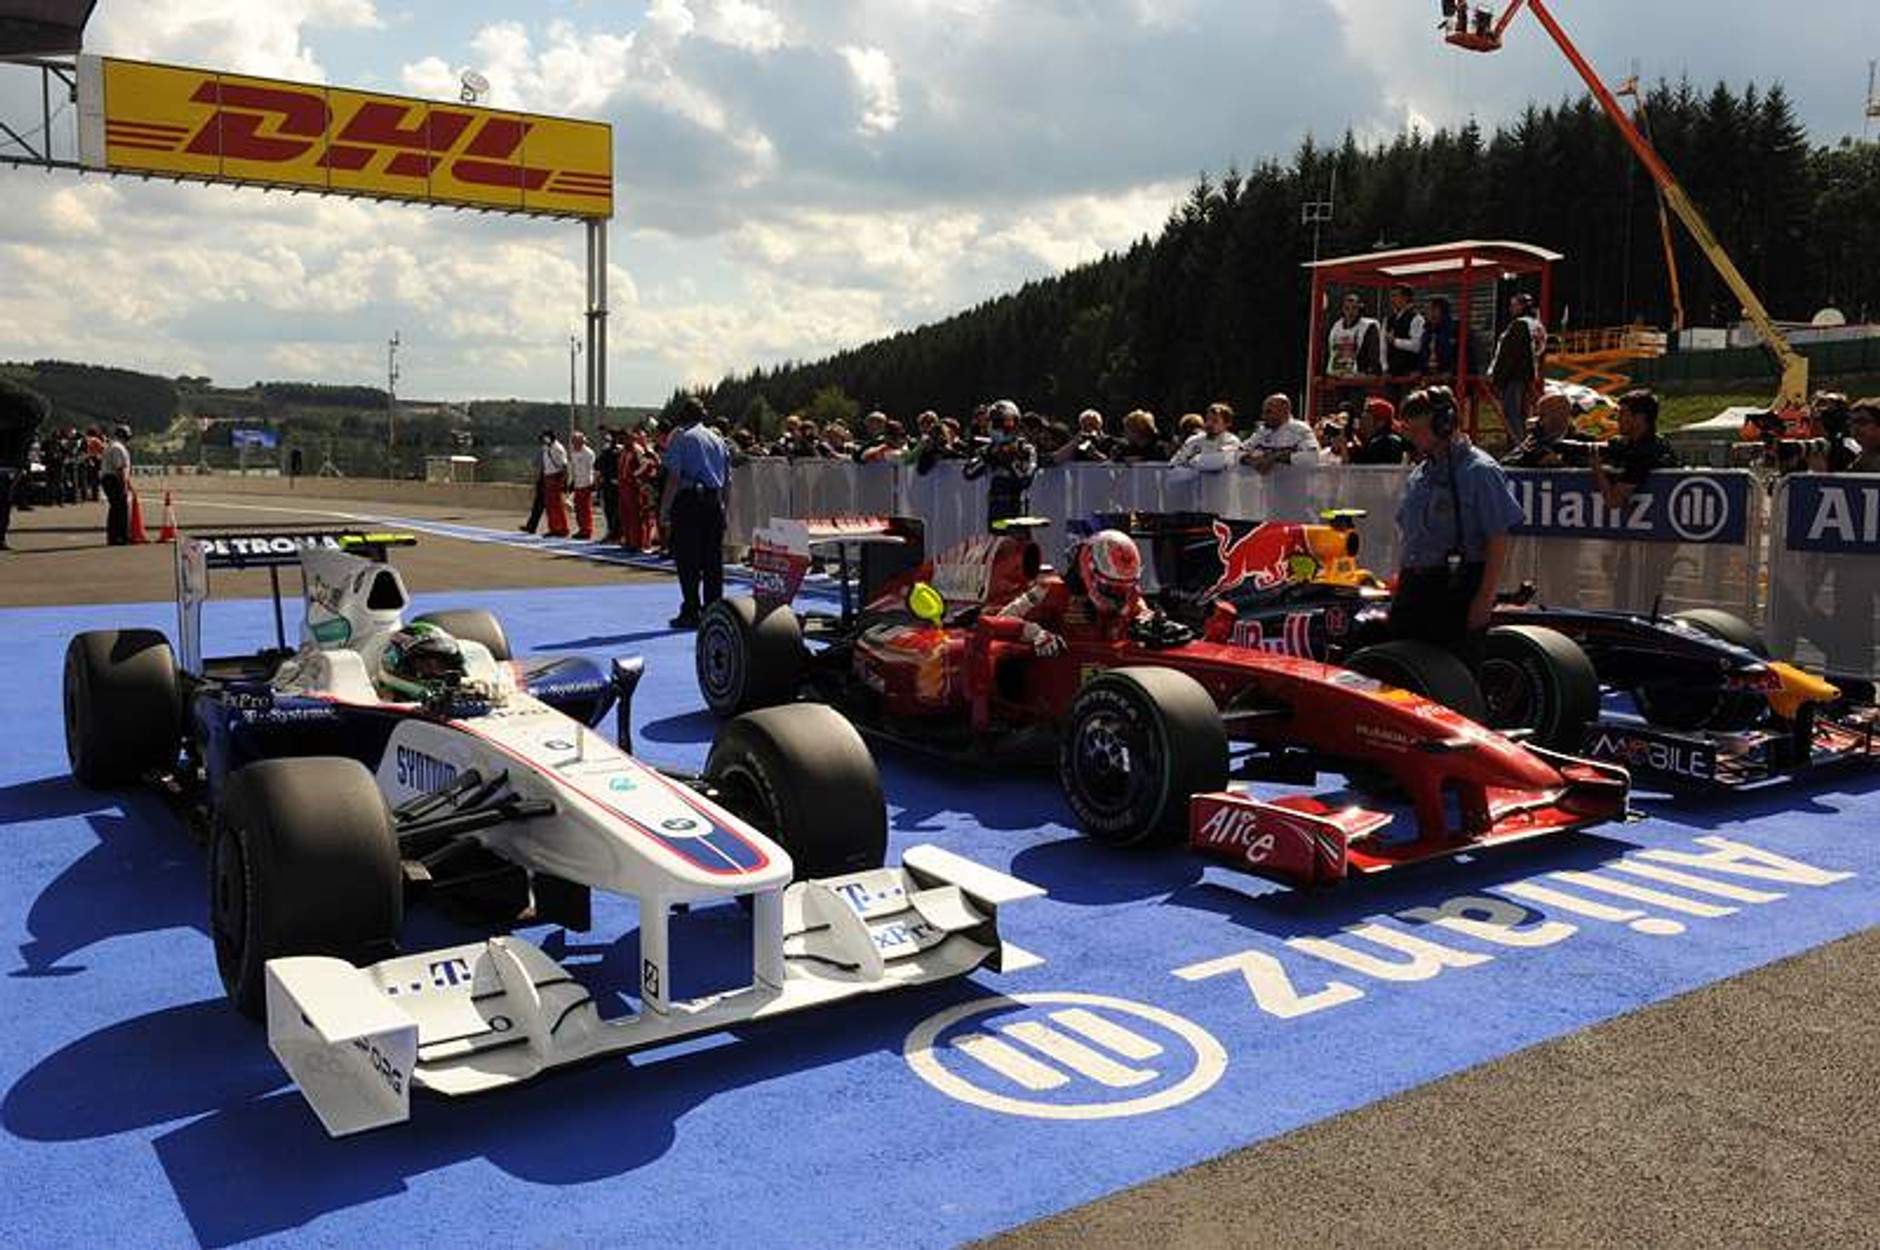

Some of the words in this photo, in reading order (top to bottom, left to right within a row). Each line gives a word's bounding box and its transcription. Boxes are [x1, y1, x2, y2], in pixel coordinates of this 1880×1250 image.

[185, 81, 553, 190] DHL
[1200, 806, 1275, 862] Alice
[1172, 836, 1856, 1018] Allianz
